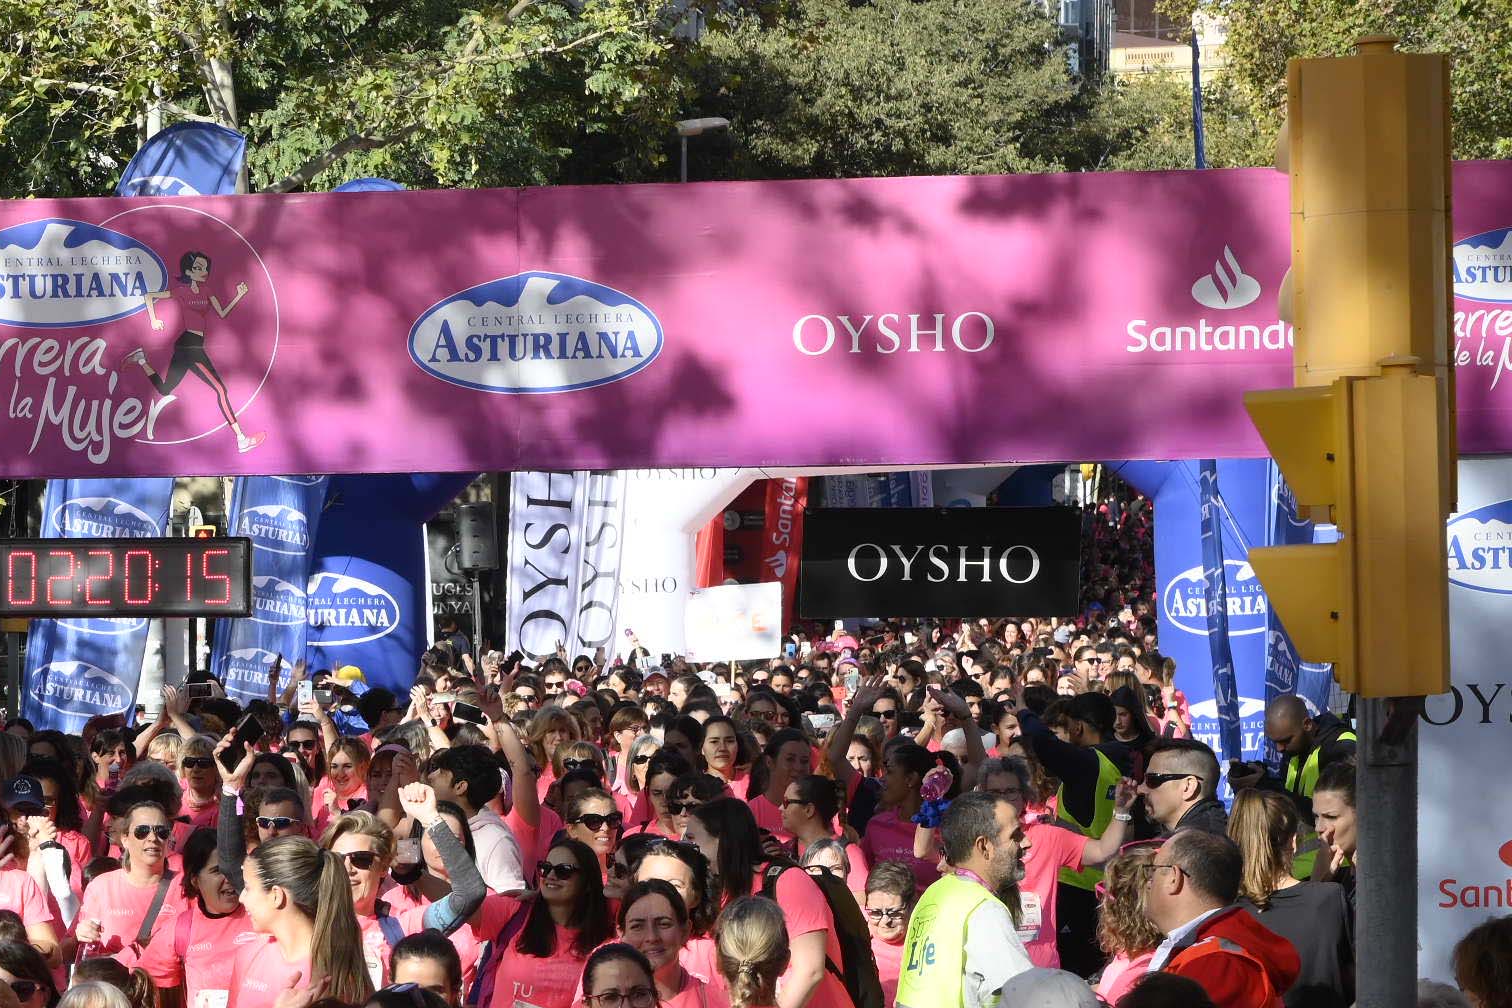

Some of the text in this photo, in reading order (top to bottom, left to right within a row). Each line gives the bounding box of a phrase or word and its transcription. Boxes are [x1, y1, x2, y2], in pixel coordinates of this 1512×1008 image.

[70, 254, 143, 267] LECHERA
[467, 312, 635, 328] CENTRAL LECHERA
[792, 310, 996, 357] OYSHO
[427, 319, 644, 363] ASTURIANA
[9, 380, 33, 419] la
[27, 371, 177, 465] Mujer
[846, 543, 1041, 585] OYSHO
[337, 596, 386, 607] LECHERA
[33, 680, 123, 709] ASTURIANA
[510, 982, 534, 998] TU
